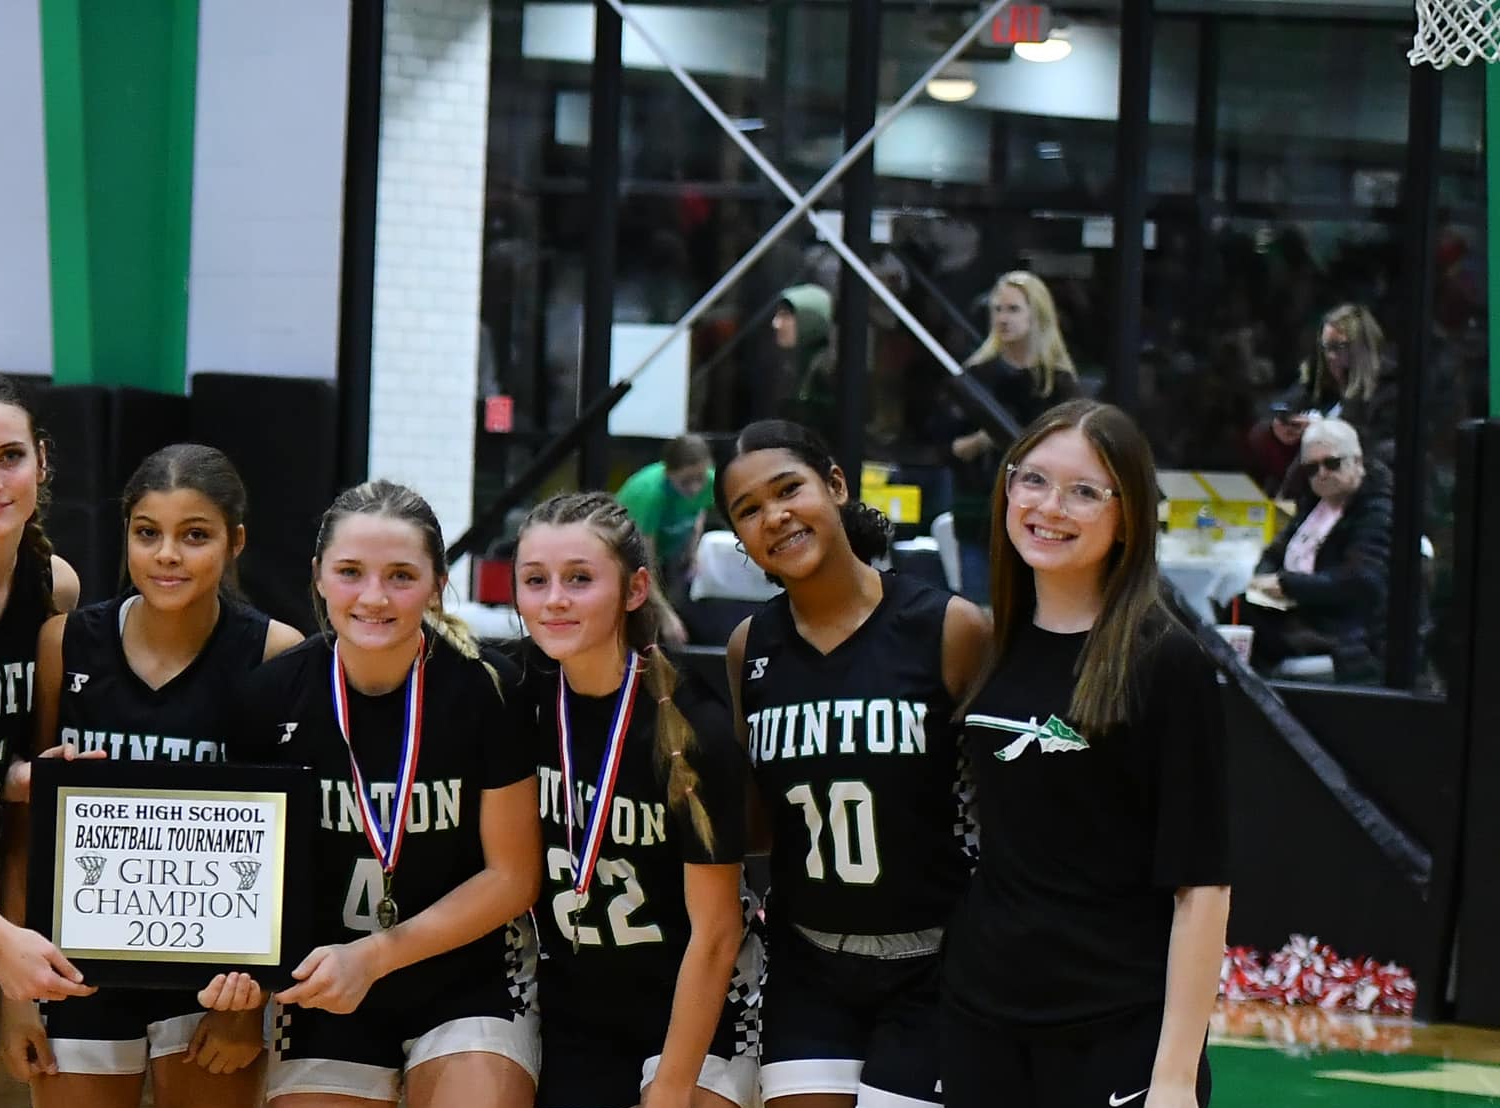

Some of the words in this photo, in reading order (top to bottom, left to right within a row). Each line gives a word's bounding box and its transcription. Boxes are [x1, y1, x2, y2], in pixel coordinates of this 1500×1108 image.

[75, 803, 129, 819] GORE
[136, 805, 183, 821] HIGH
[188, 806, 265, 823] SCHOOL
[320, 777, 462, 834] INTON
[75, 825, 162, 850] BASKETBALL
[167, 828, 265, 854] TOURNAMENT
[785, 779, 881, 885] 10
[118, 858, 220, 886] GIRLS
[74, 887, 260, 918] CHAMPION
[547, 847, 663, 946] 22
[126, 920, 204, 948] 2023
